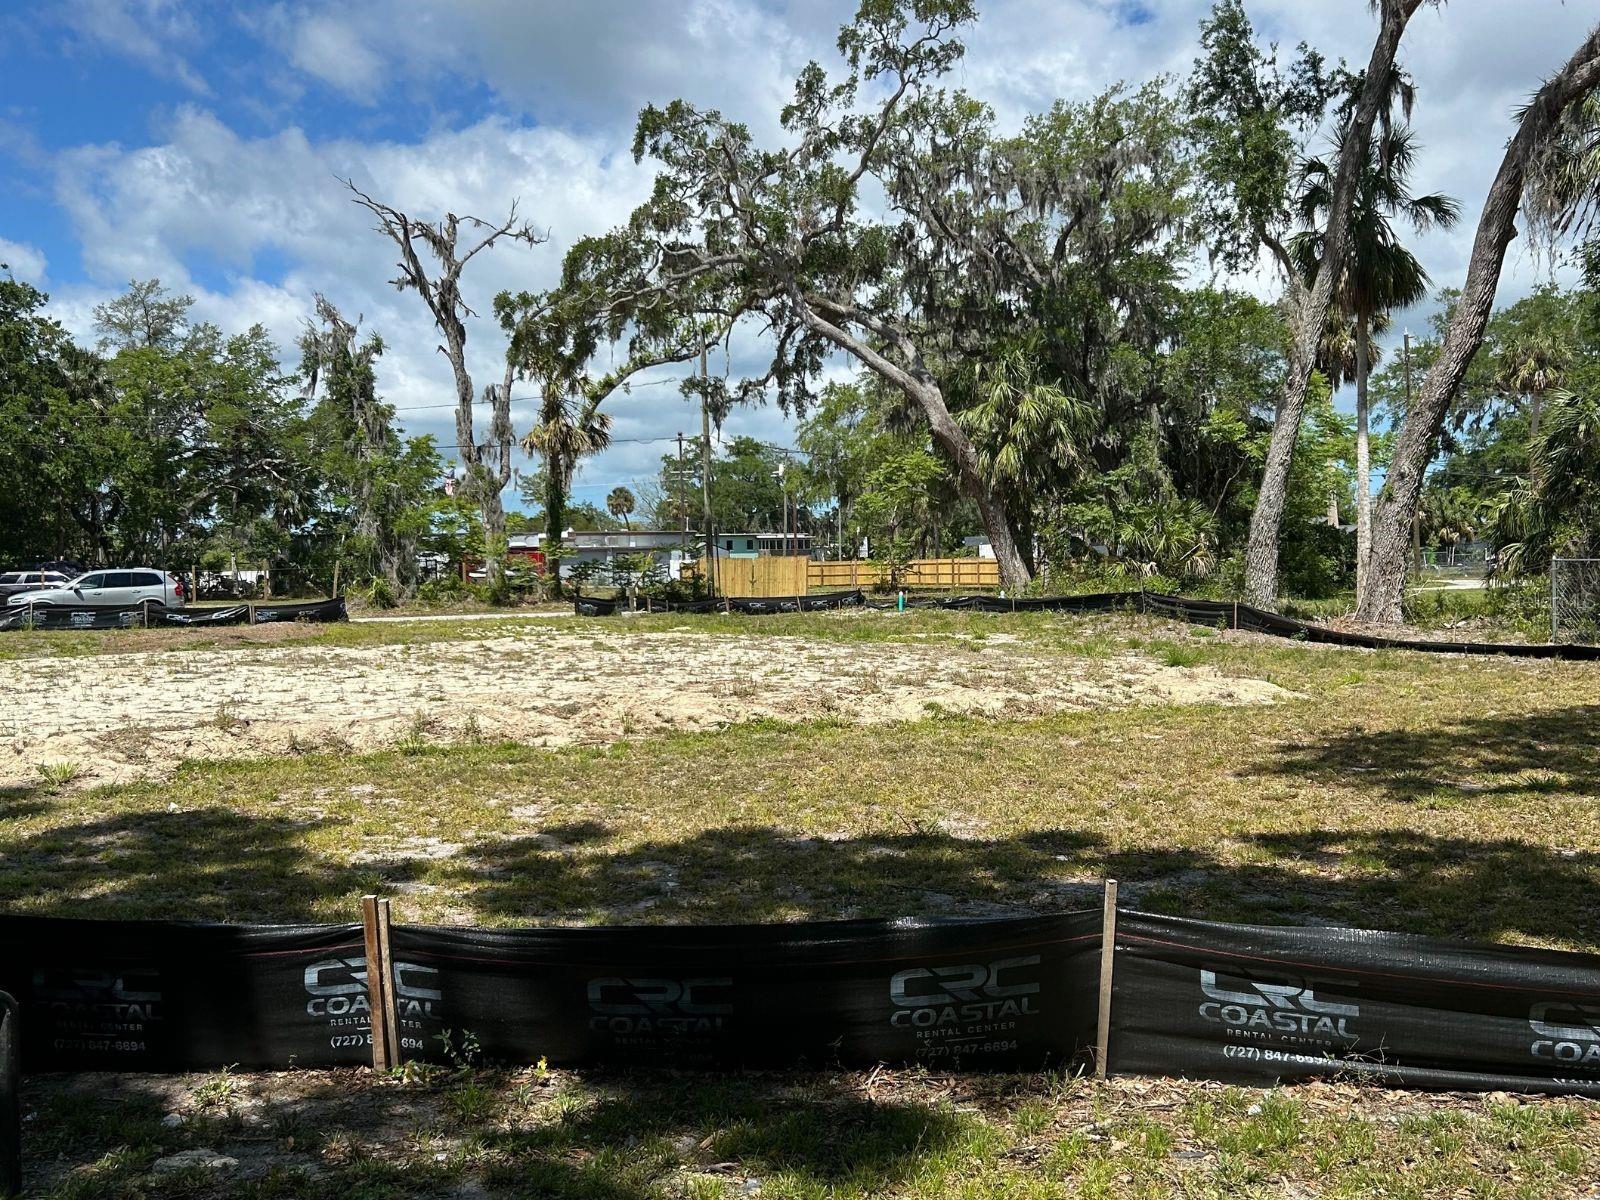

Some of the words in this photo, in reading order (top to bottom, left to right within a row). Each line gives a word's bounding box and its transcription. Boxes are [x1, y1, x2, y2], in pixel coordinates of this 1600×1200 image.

[890, 954, 1041, 1007] CRC
[1200, 964, 1360, 1017] CRC
[306, 995, 444, 1021] COATAL
[586, 976, 735, 1015] CRC
[330, 1016, 372, 1027] RENTAL
[890, 996, 1040, 1029] COASTAL
[1199, 1001, 1360, 1040] COASTAL
[330, 1035, 364, 1049] (727)
[916, 1027, 961, 1039] RENTAL
[967, 1021, 1016, 1034] CENTER
[1226, 1028, 1273, 1042] RENTAL
[1222, 1045, 1260, 1061] (727)
